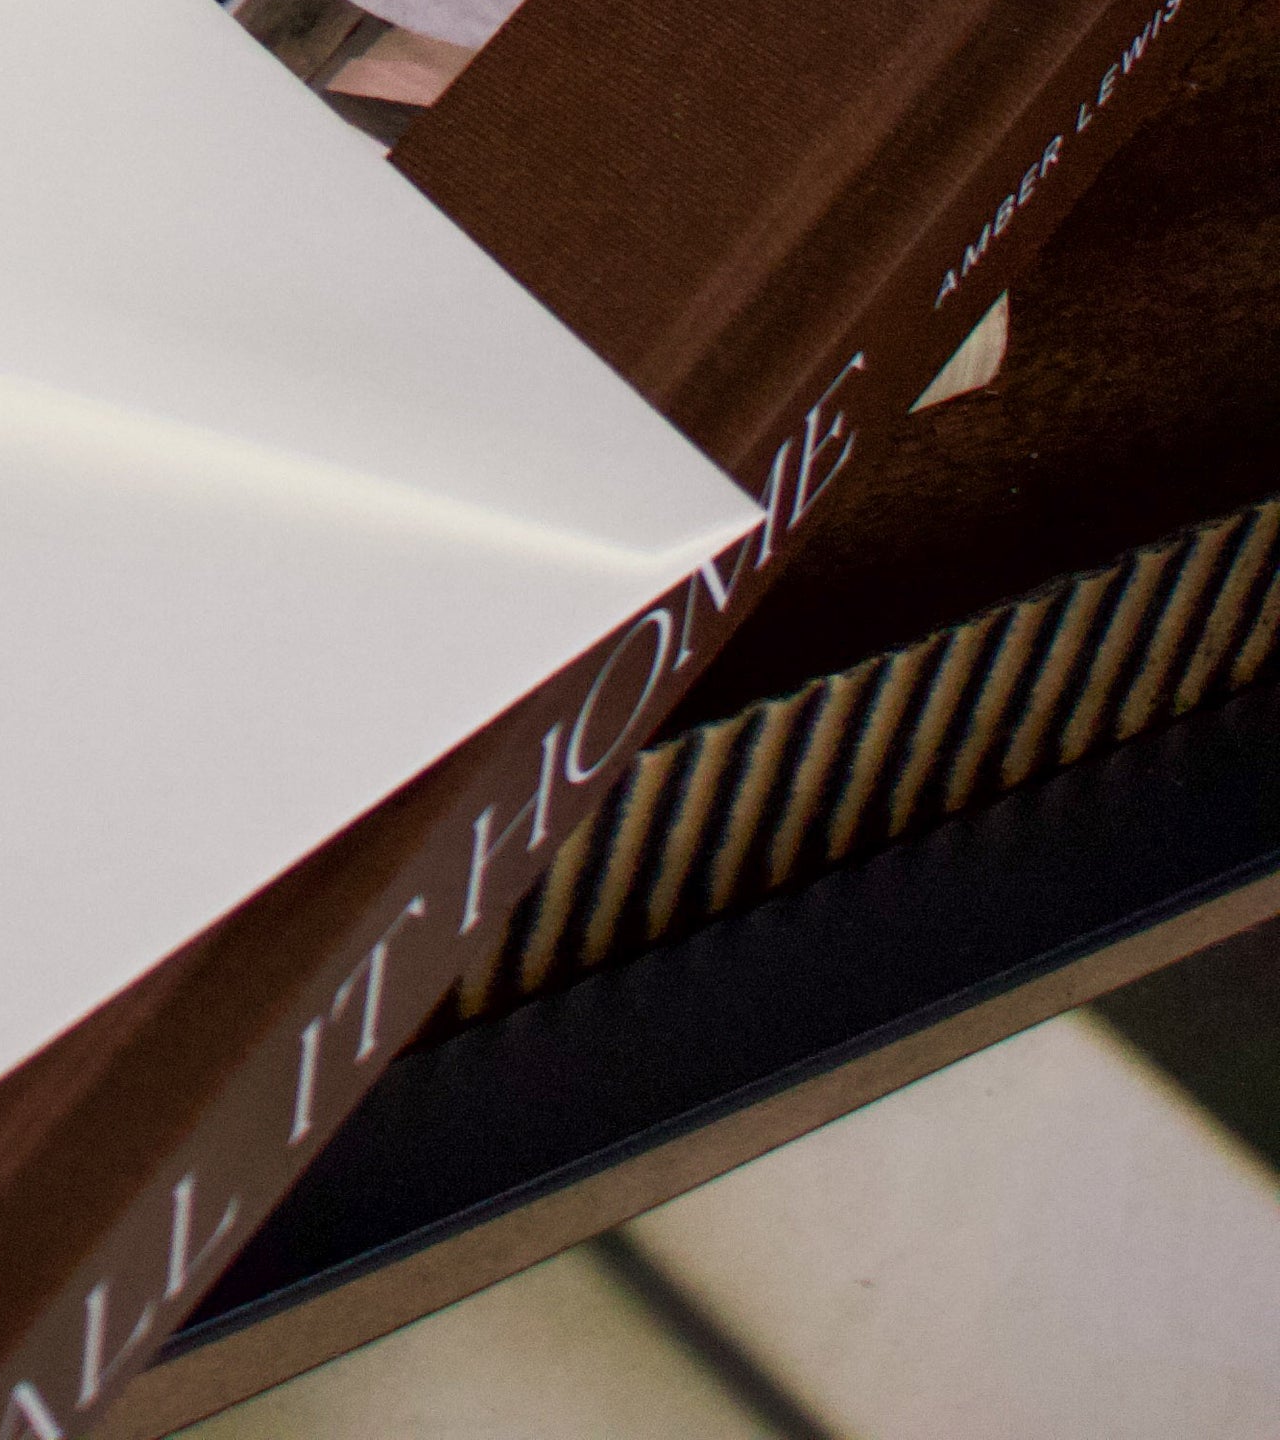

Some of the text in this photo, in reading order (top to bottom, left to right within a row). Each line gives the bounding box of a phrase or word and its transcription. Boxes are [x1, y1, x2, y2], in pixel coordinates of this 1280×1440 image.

[934, 134, 1064, 309] AMBER
[287, 893, 425, 1145] IT
[458, 350, 866, 936] HOME
